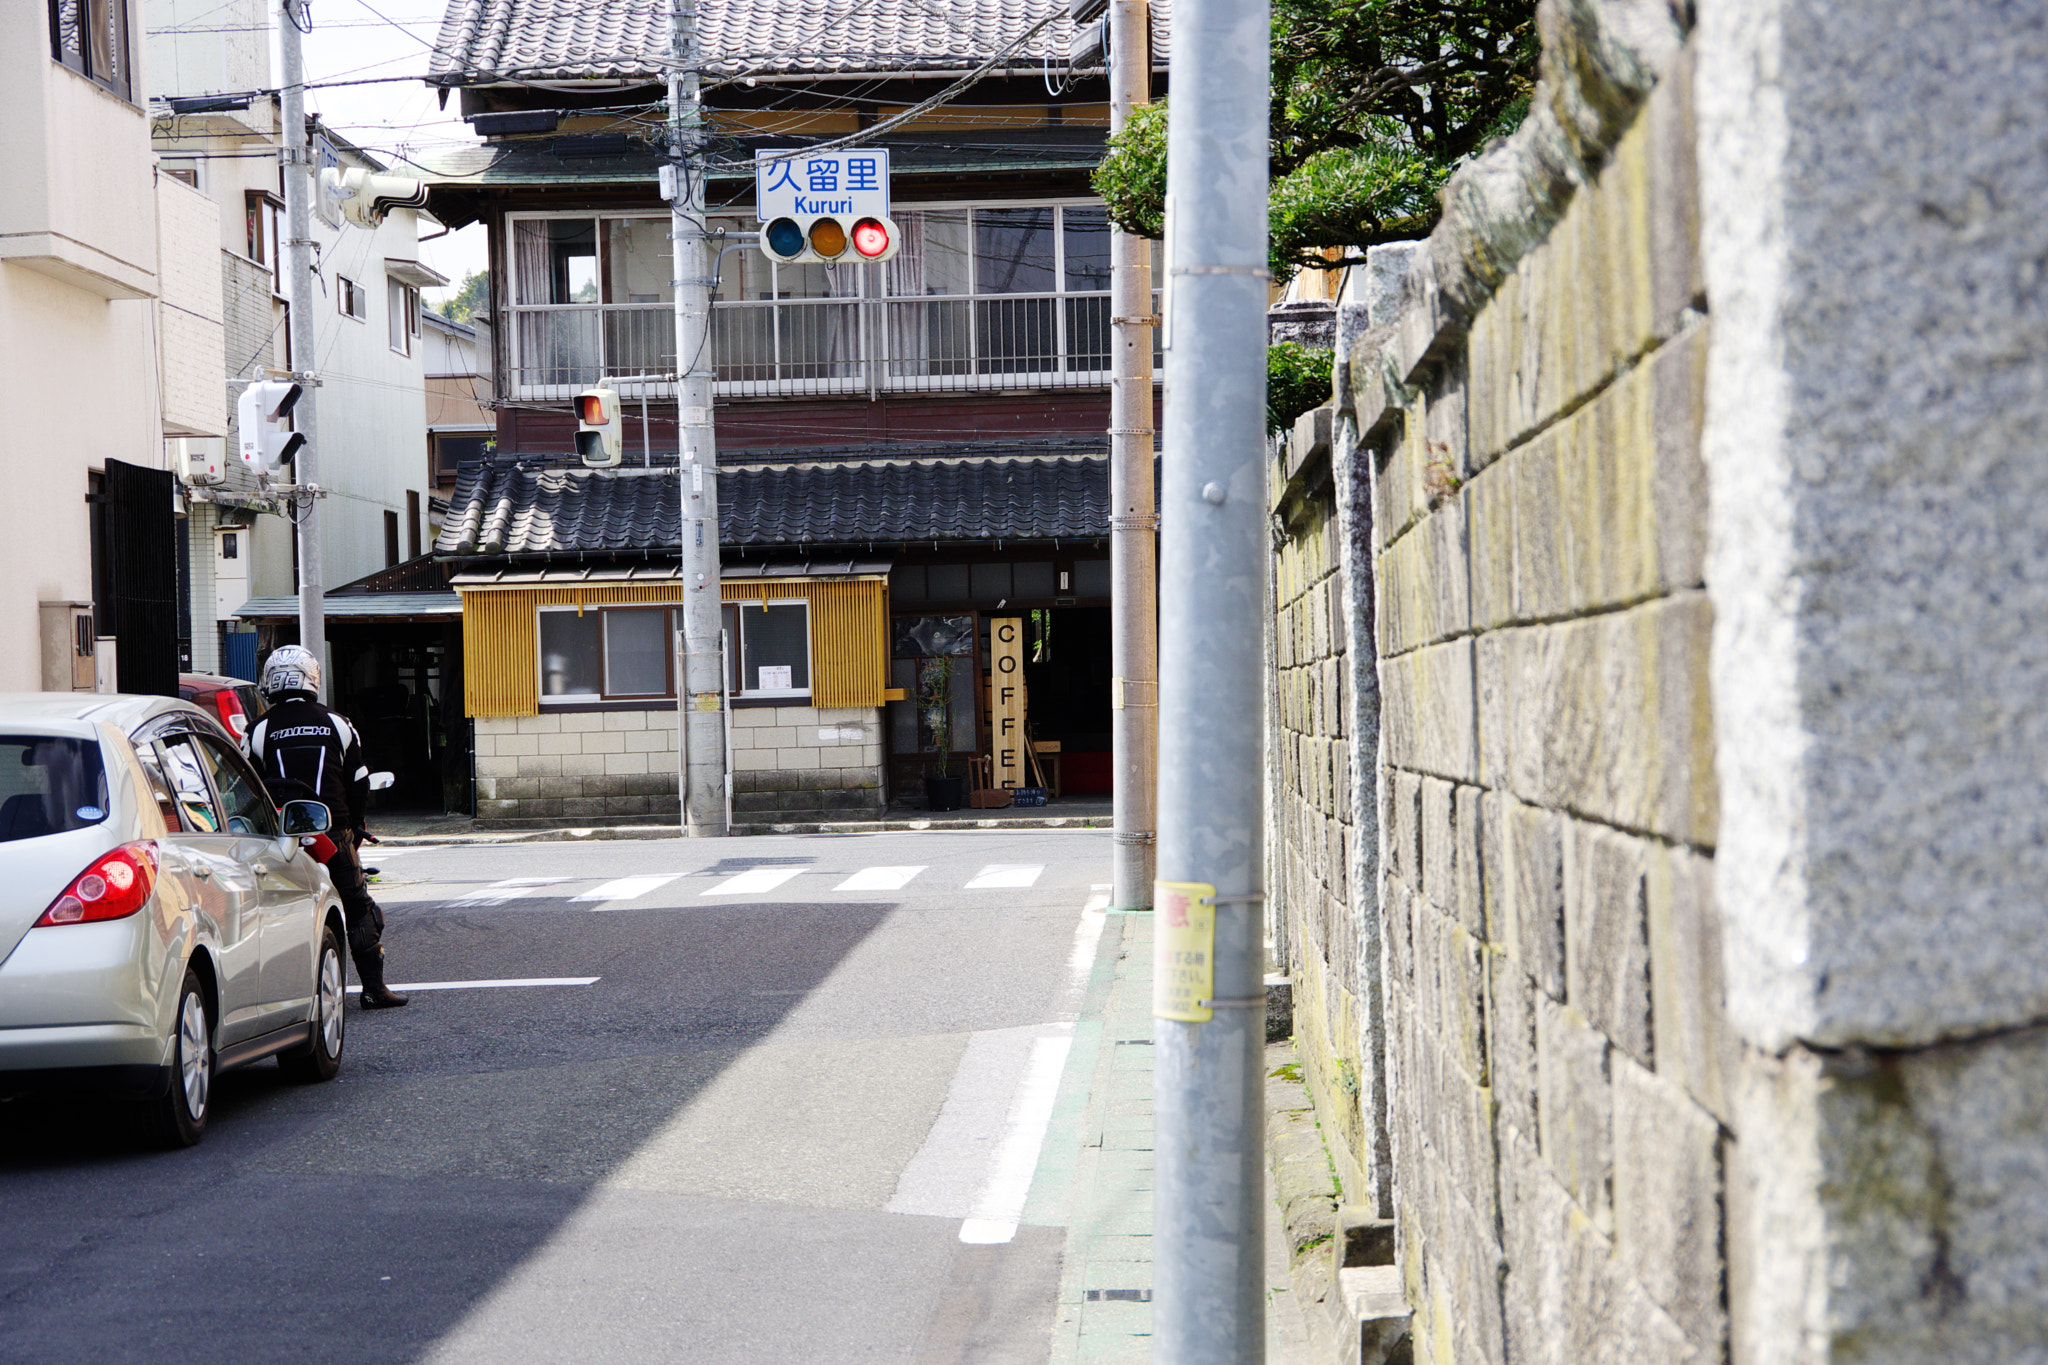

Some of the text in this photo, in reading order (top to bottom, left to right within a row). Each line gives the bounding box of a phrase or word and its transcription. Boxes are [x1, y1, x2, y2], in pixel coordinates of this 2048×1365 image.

[768, 157, 880, 192] 久留里
[794, 196, 853, 214] Kururi
[998, 624, 1017, 798] COFFEE
[269, 725, 331, 741] TAICHI
